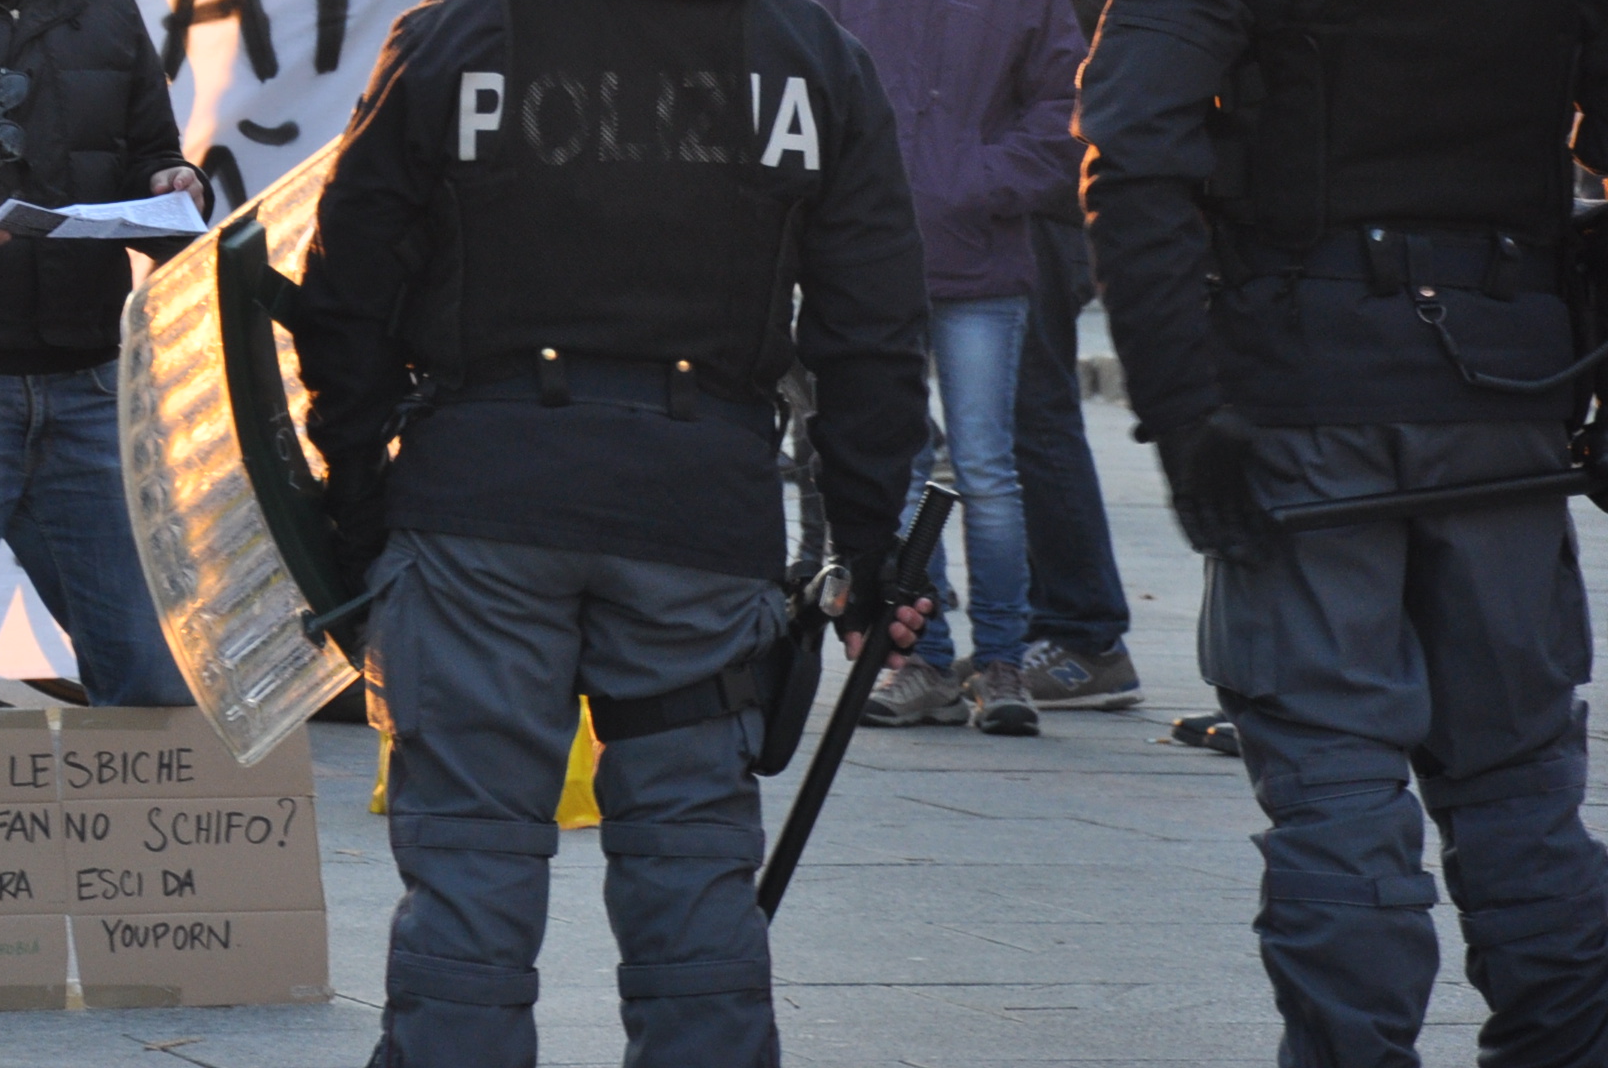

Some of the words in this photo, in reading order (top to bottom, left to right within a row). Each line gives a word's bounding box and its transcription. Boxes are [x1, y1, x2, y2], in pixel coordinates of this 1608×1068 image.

[9, 747, 195, 789] LESBICHE
[144, 798, 297, 852] SCHIFO?
[77, 868, 143, 901] ESCI
[162, 869, 197, 898] DA
[102, 919, 231, 953] YOUPORN
